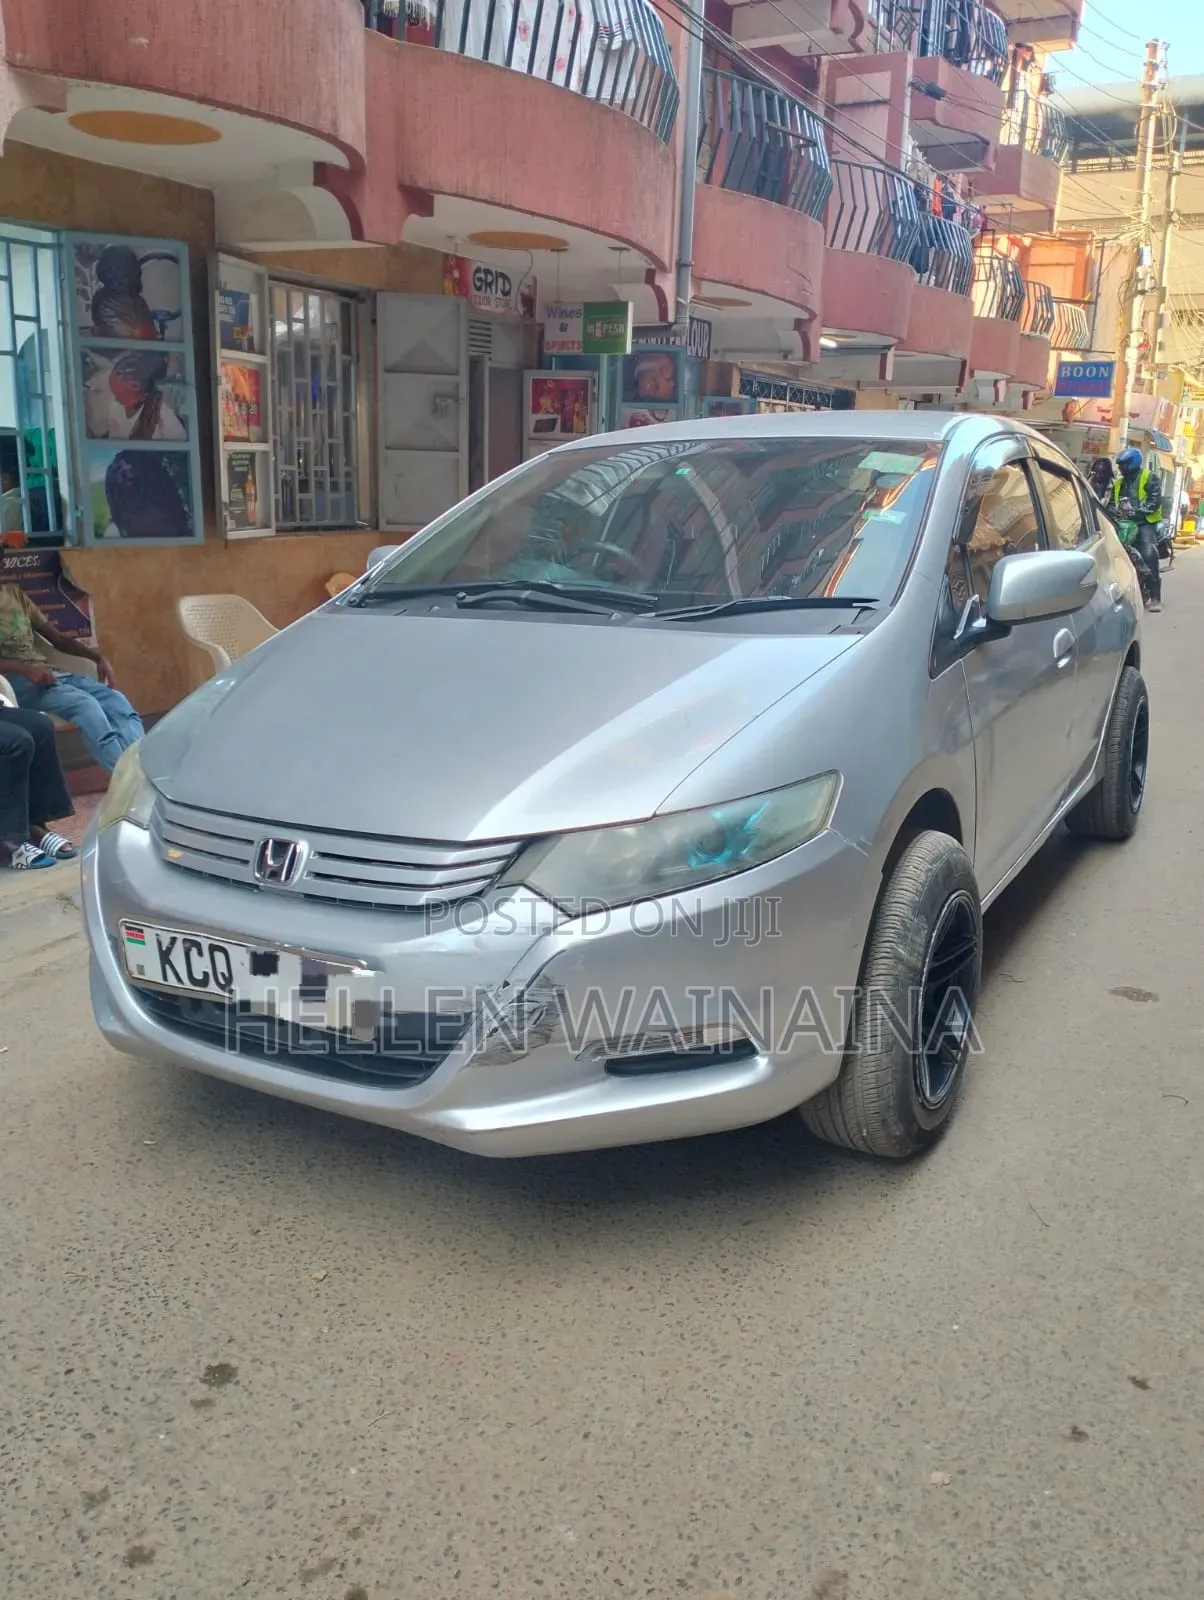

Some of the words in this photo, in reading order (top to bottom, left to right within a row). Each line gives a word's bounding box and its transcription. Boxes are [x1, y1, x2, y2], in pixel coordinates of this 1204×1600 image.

[472, 266, 512, 297] GRID
[495, 296, 514, 310] STORE
[546, 304, 582, 319] Wines
[544, 340, 582, 351] SPIRITS
[1061, 366, 1110, 378] BOON
[155, 932, 234, 994] KCQ
